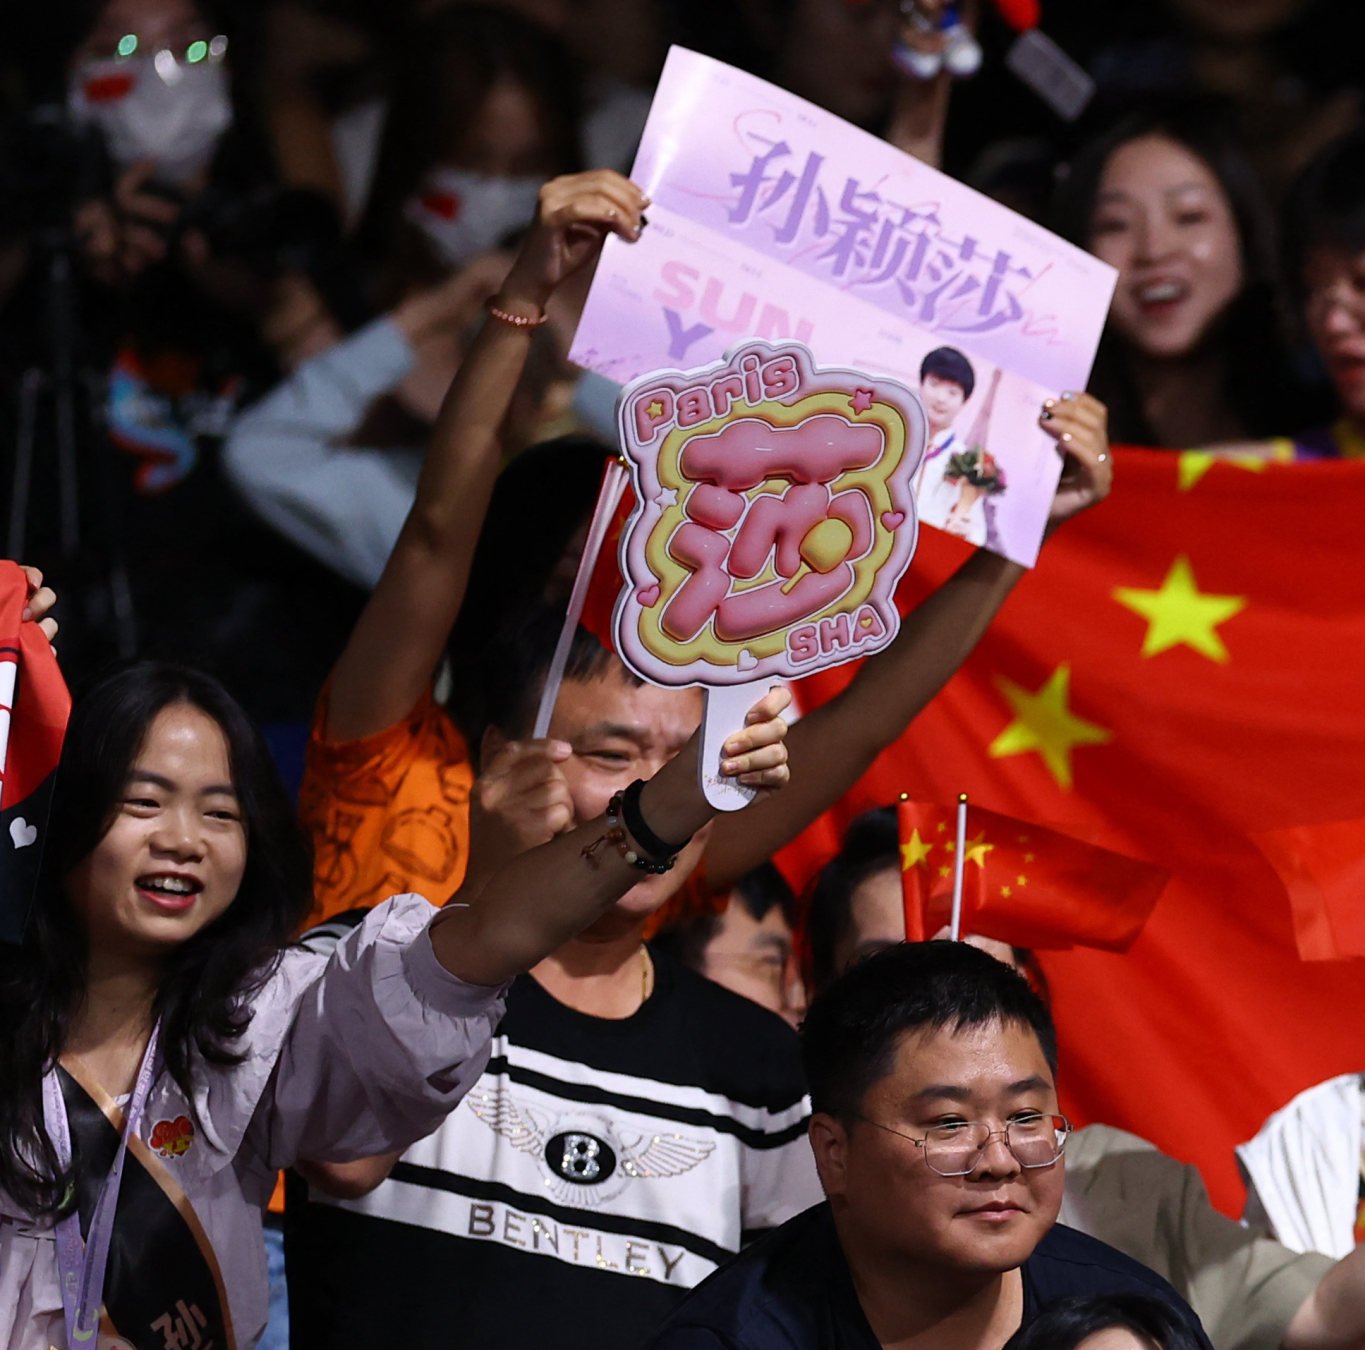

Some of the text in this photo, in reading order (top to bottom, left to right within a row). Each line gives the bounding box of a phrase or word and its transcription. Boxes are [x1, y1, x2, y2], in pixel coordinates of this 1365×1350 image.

[728, 131, 1033, 333] 孙颖莎
[654, 261, 815, 345] SUN
[634, 354, 800, 446] Paris
[786, 607, 885, 668] SHA
[466, 1202, 686, 1281] BENTLEY
